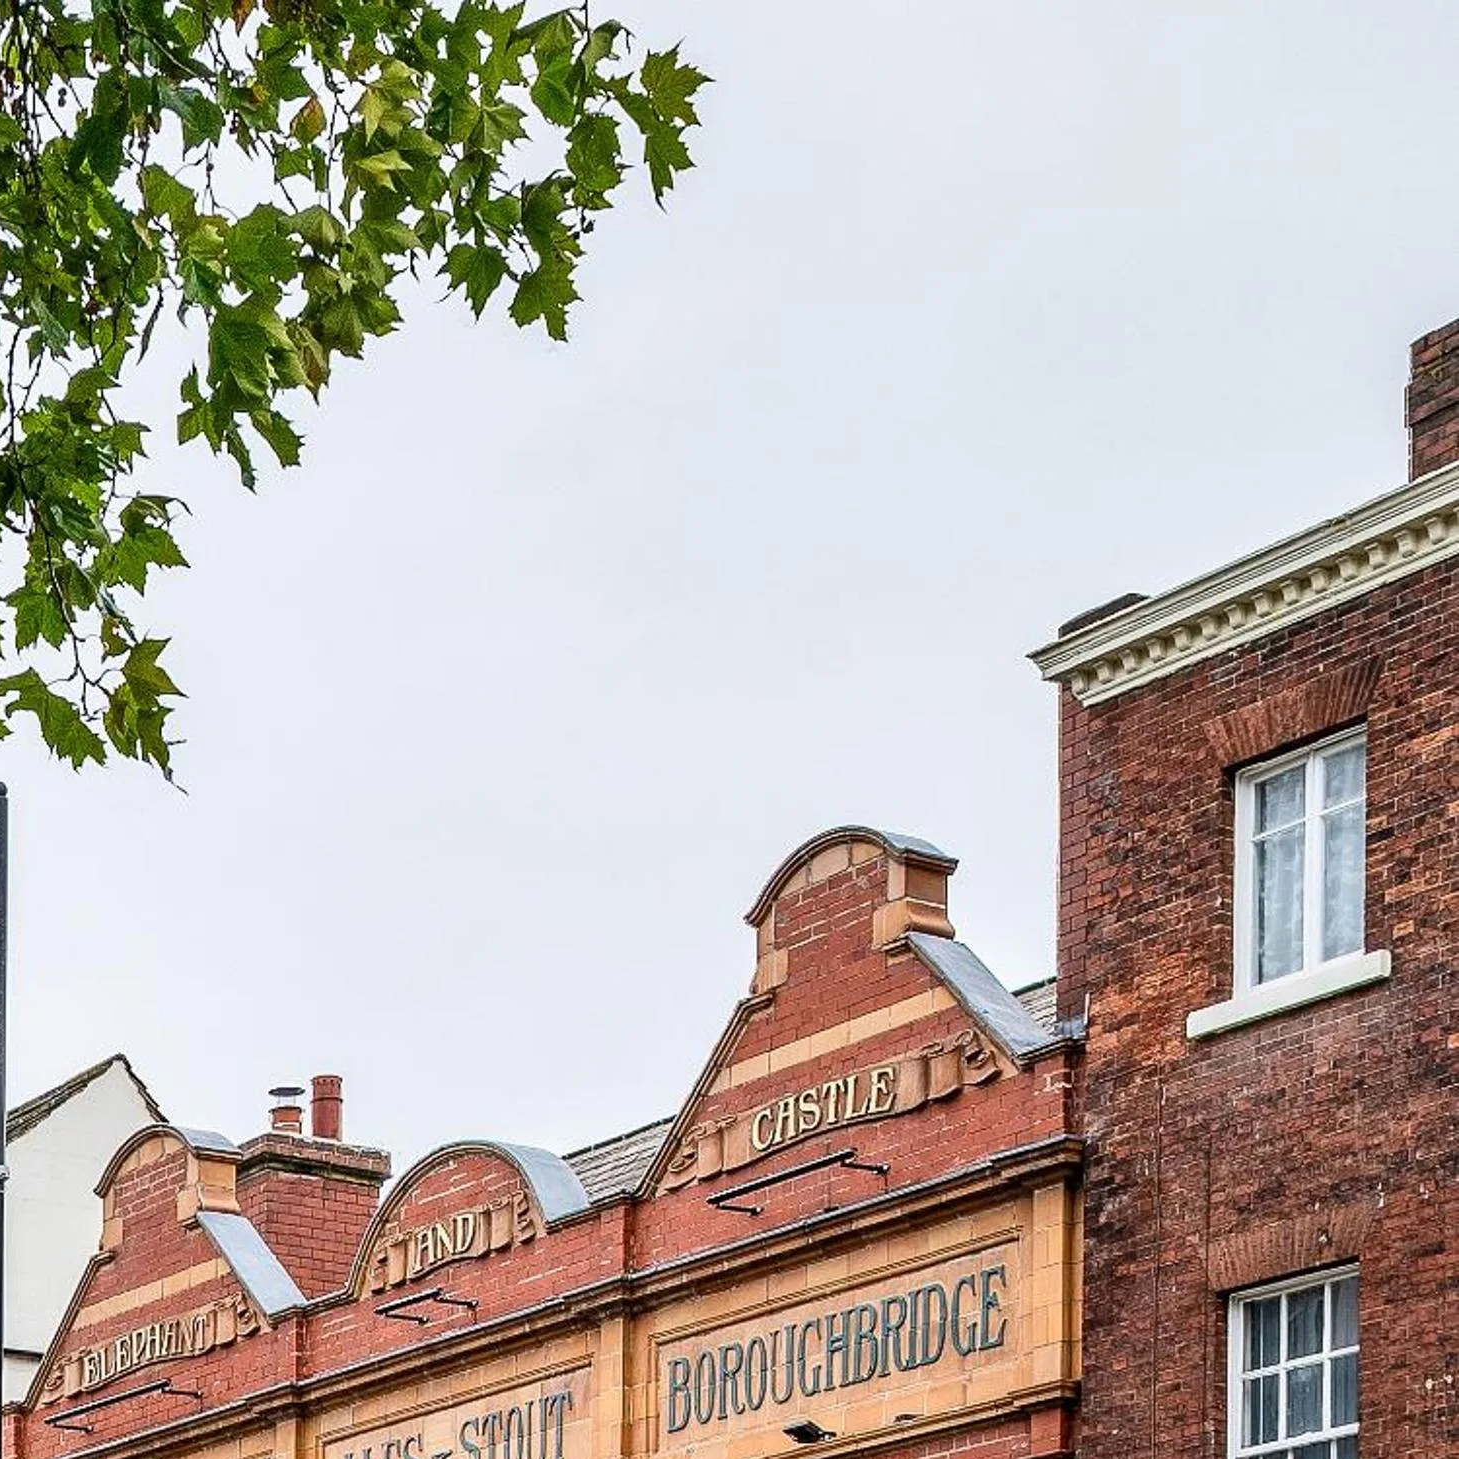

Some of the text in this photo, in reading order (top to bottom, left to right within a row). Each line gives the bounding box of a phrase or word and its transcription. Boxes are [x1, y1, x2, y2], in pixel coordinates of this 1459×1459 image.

[751, 1066, 896, 1152] CASTLE
[412, 1213, 477, 1274] AND
[83, 1314, 208, 1387] ELEPHANT
[666, 1264, 1008, 1434] BOROUGHBRIDGE
